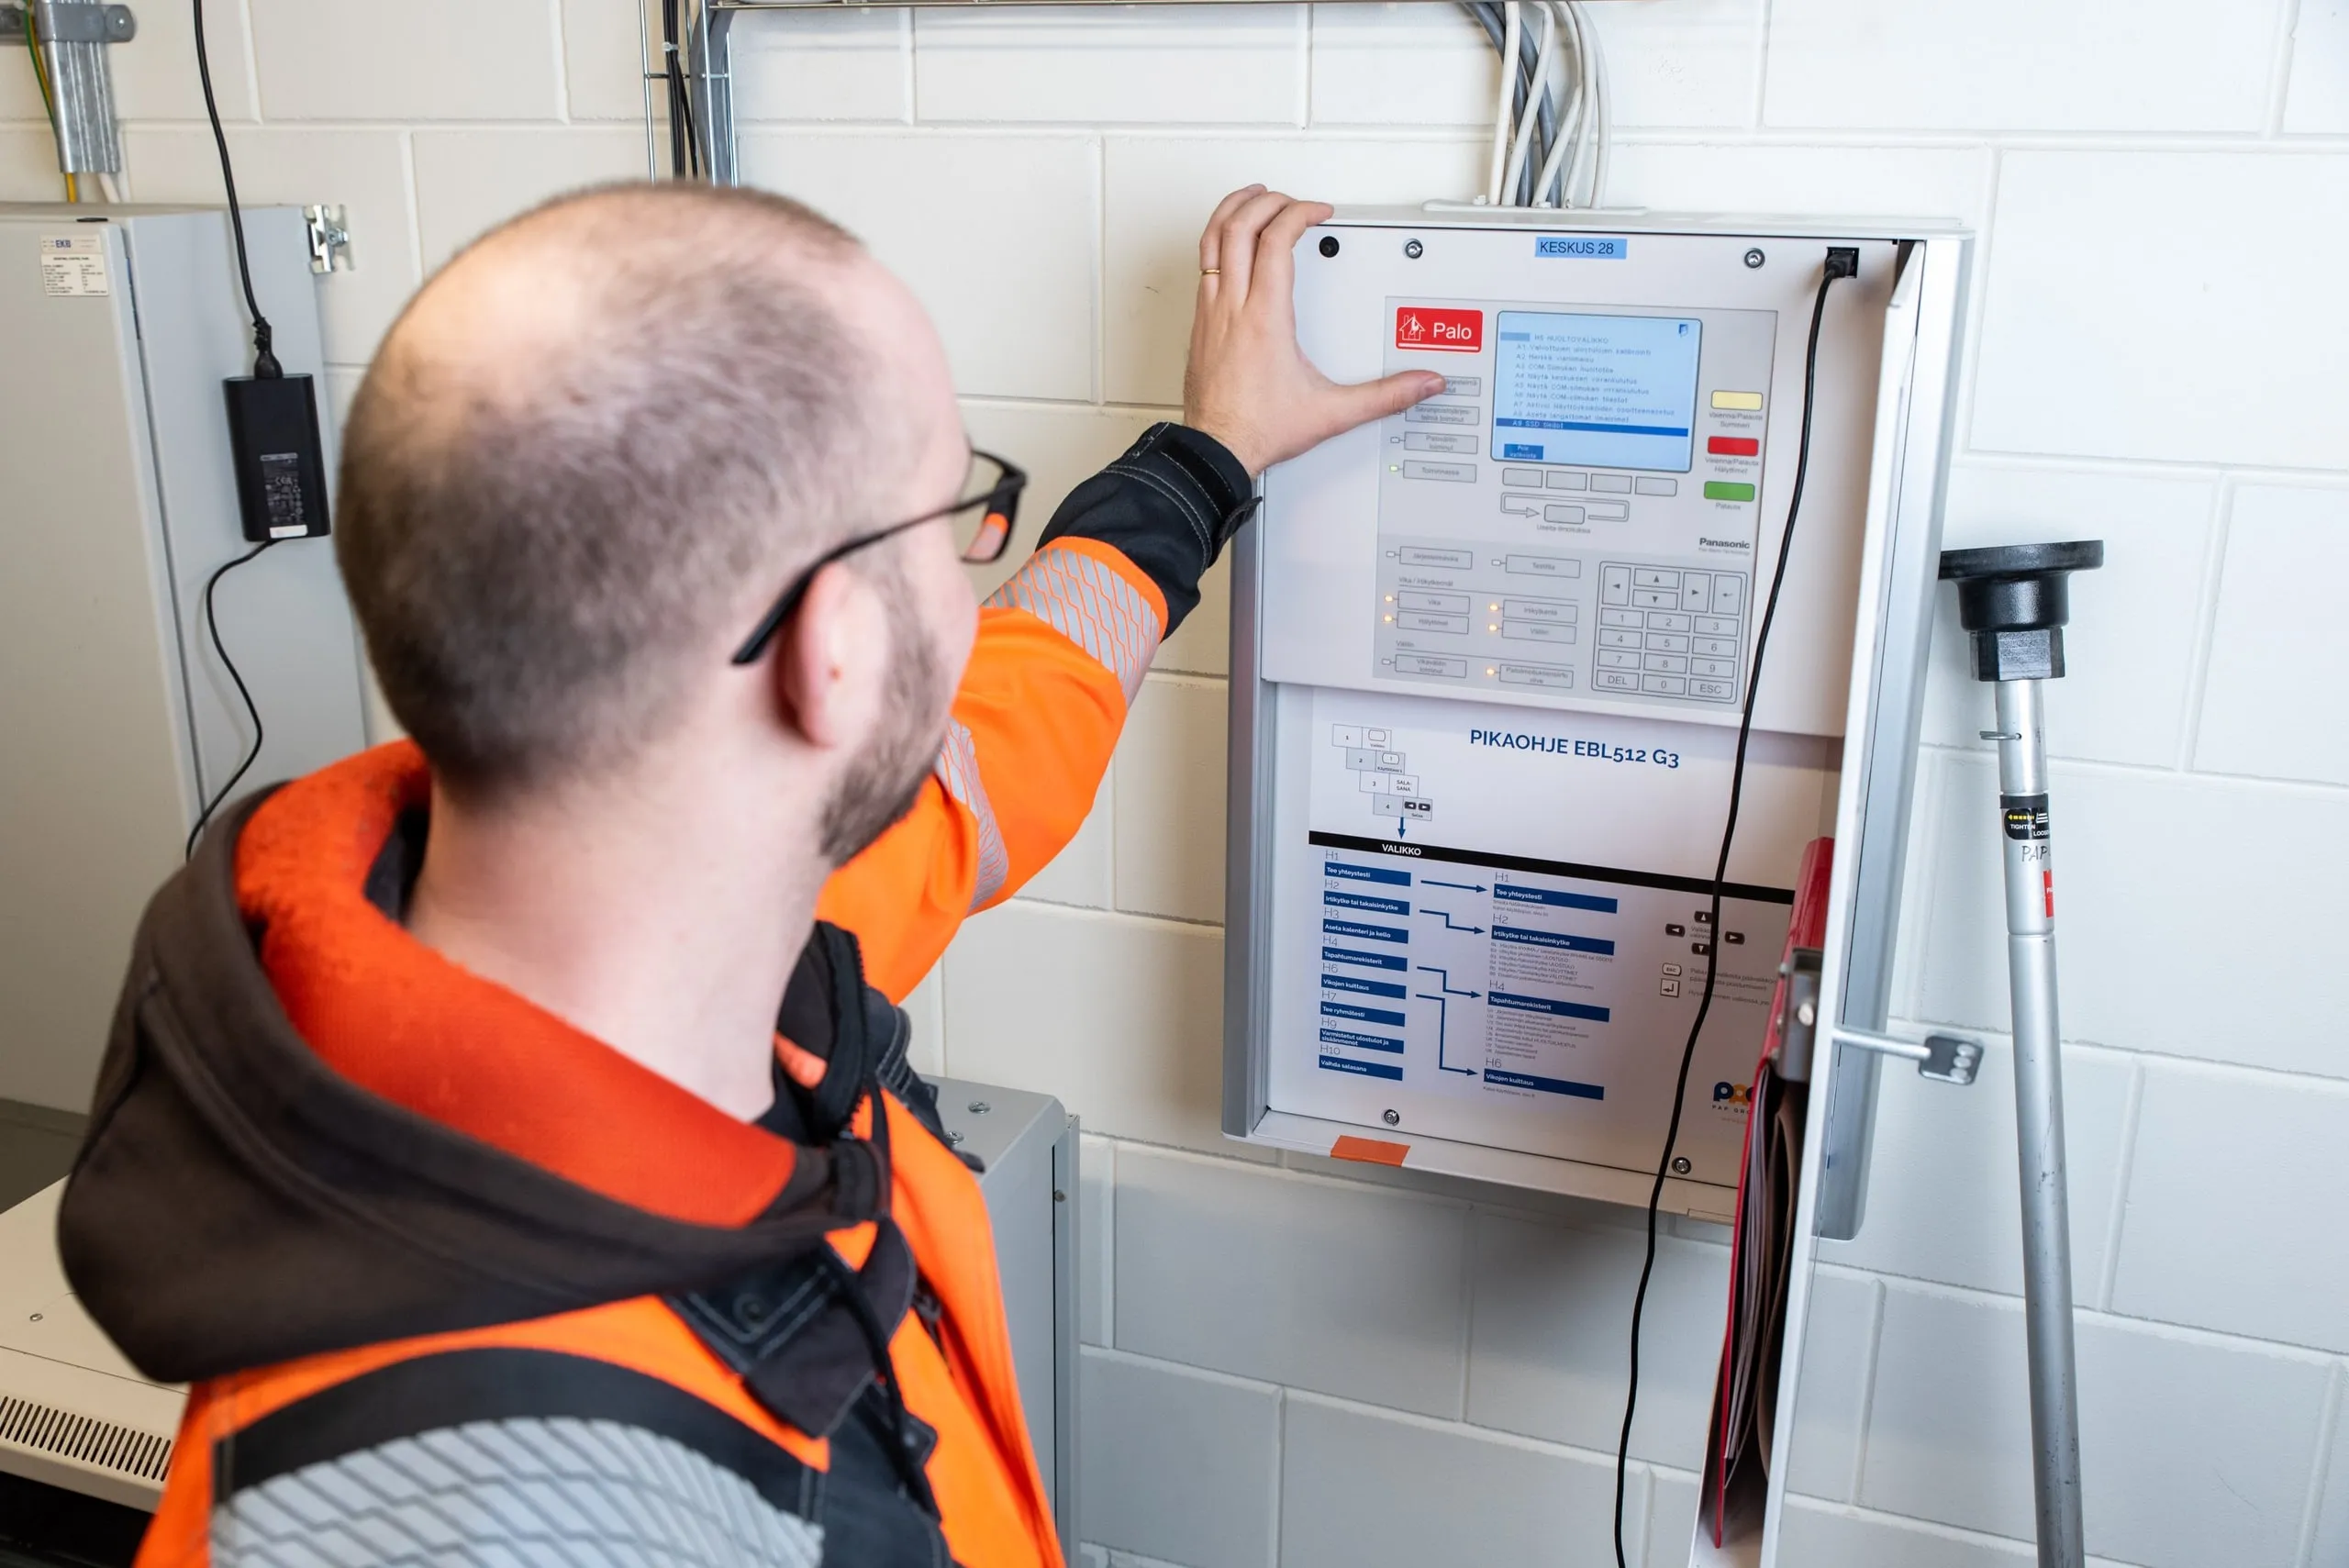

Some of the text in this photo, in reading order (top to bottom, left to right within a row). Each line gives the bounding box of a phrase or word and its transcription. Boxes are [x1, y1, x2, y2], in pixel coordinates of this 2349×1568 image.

[56, 239, 72, 249] EKB
[1540, 241, 1614, 255] KESKUS 28
[1433, 322, 1472, 340] Palo
[1699, 537, 1751, 550] Panasonic
[1665, 618, 1672, 627] 2
[1712, 622, 1720, 631] 3
[1617, 635, 1623, 643] 4
[1664, 639, 1670, 648] 5
[1710, 643, 1718, 652] 6
[1616, 655, 1622, 664] 7
[1663, 660, 1669, 669] 8
[1709, 664, 1716, 673] 9
[1608, 675, 1628, 685] DEL
[1699, 684, 1722, 695] ESC
[1470, 728, 1680, 769] PIKAOHJE EBL512 G3
[1325, 850, 1340, 862] H1
[1382, 843, 1422, 857] VALIKKO
[1338, 867, 1371, 879] yhteystesti
[1495, 872, 1510, 883] H1
[1324, 879, 1340, 890] H2
[1508, 890, 1542, 901] yhteystesti
[1325, 895, 1350, 906] Irtikytke
[1360, 899, 1398, 912] takaisinkytke
[1324, 906, 1340, 919] H3
[1493, 913, 1508, 925] H2
[1324, 923, 1391, 939] Aseta kalenteri ja kello
[1323, 935, 1338, 947] H4
[1494, 930, 1520, 940] Irtikytke
[1529, 934, 1571, 947] takaisinkytke
[1324, 951, 1383, 965] Tapahtumarekisterit
[1322, 962, 1339, 973] H6
[1323, 979, 1370, 991] Vikojen kuittaus
[1489, 979, 1505, 992] H4
[1321, 990, 1337, 1002] H7
[1490, 995, 1552, 1010] Tapahtumarekisterit
[1333, 1006, 1365, 1018] ryhmätesti
[1321, 1018, 1337, 1029] H9
[1321, 1029, 1356, 1041] Varmistetut
[1356, 1034, 1383, 1045] ulostulot
[1321, 1036, 1359, 1047] sisäänmenot
[1319, 1044, 1341, 1055] H10
[1321, 1059, 1367, 1073] Vaihda salasana
[1486, 1056, 1502, 1069] H6
[1486, 1073, 1534, 1087] Vikojen kuittaus
